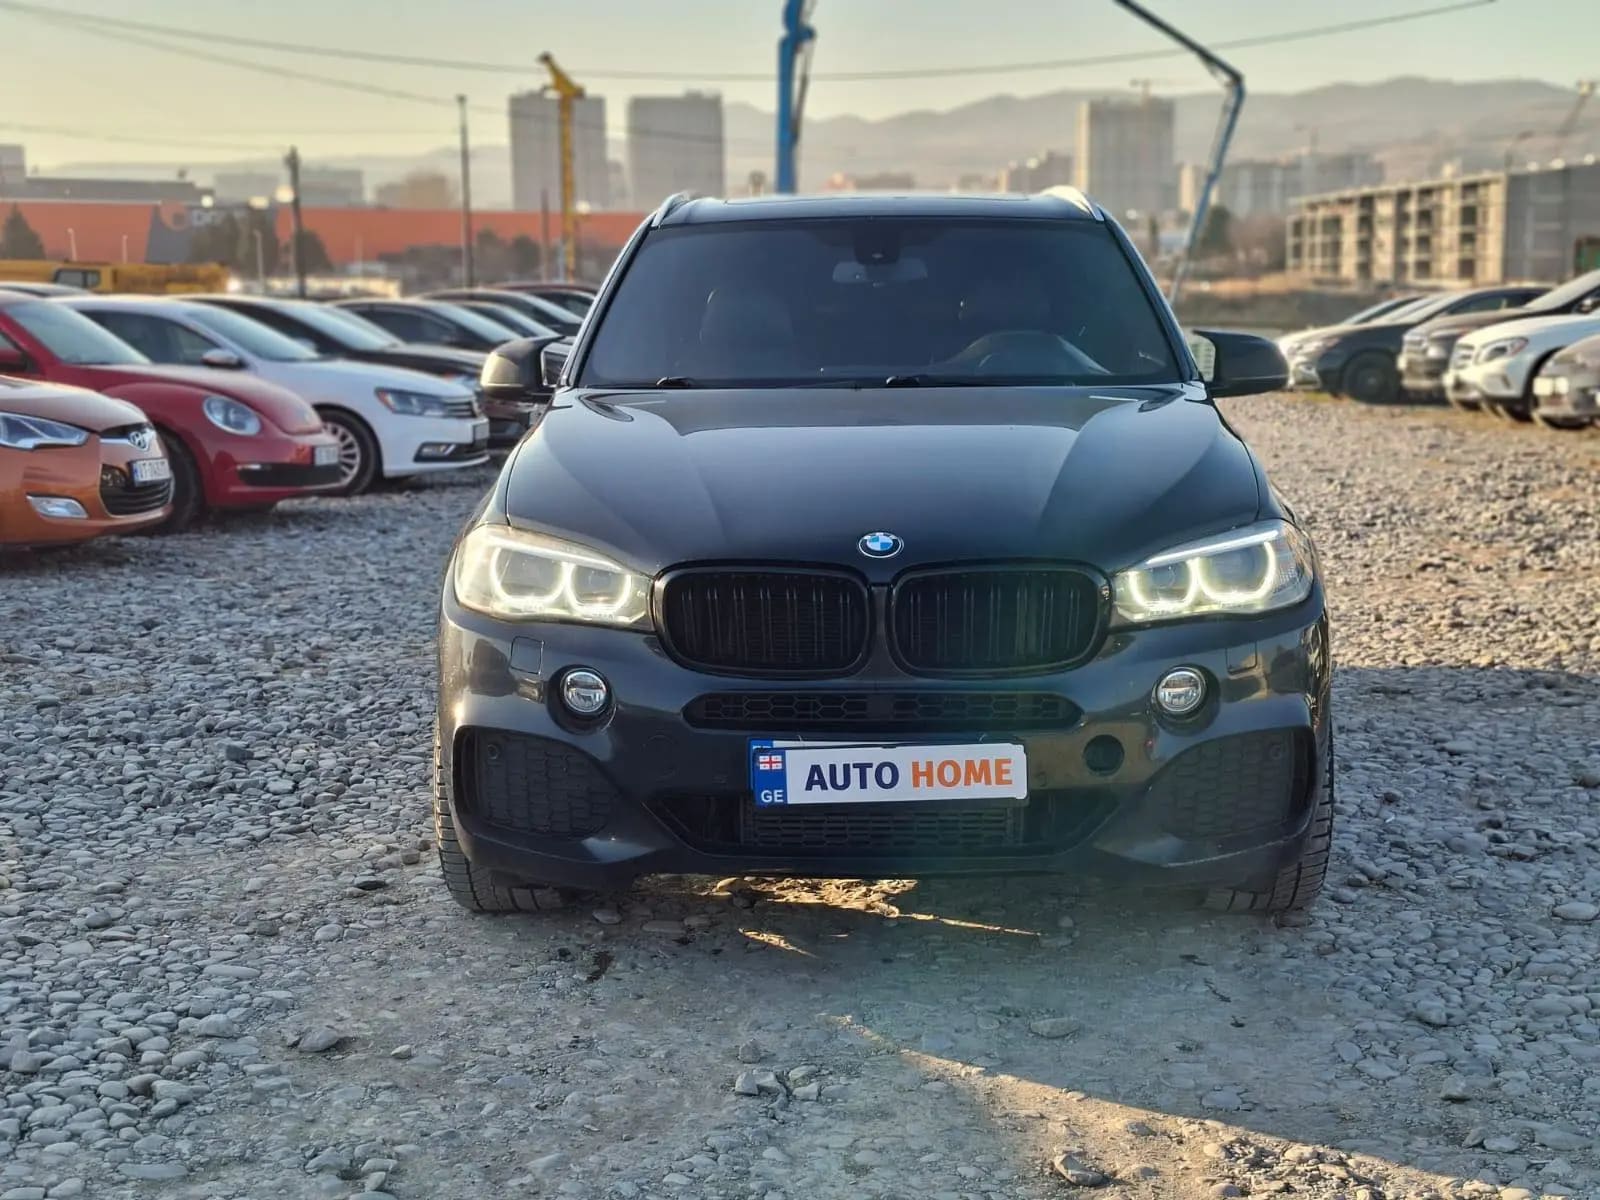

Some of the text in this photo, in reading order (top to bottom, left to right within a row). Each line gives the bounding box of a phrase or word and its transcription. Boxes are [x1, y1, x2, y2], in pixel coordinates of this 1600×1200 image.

[805, 758, 1012, 791] AUTO HOME
[761, 790, 784, 802] GE
